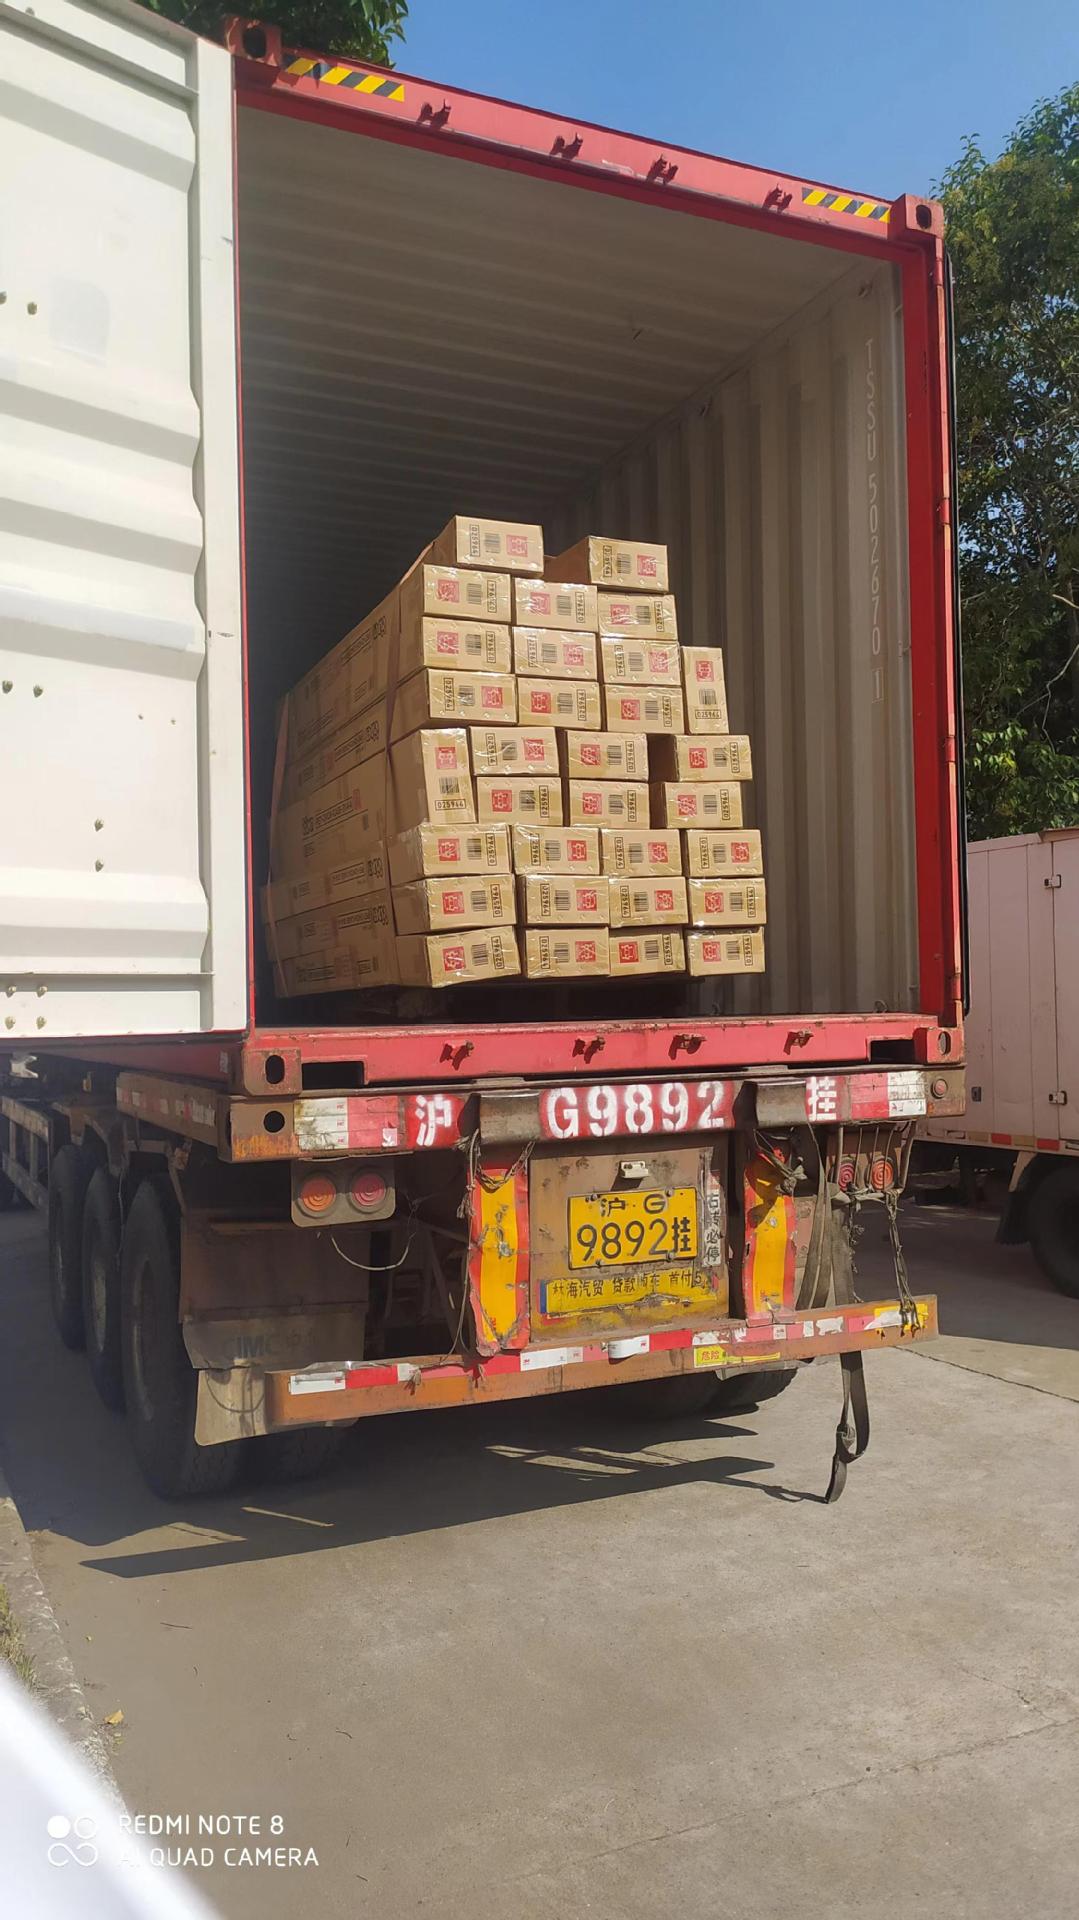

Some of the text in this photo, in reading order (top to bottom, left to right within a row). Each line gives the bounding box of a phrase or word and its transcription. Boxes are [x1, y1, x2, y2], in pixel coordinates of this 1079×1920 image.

[865, 339, 883, 701] TSSU 502670 1
[471, 525, 480, 556] 025964
[487, 632, 495, 662] 025964
[445, 679, 454, 710] 025964
[578, 690, 586, 719] 025964
[696, 710, 721, 718] 025964
[486, 734, 497, 765] 02594
[626, 742, 635, 771] 025964
[436, 800, 465, 810] 025964
[540, 786, 549, 817] 025964
[628, 791, 636, 821] 025964
[721, 790, 729, 819] 025964
[487, 834, 496, 865] 025964
[531, 834, 540, 865] 25964
[615, 838, 624, 868] 025964
[700, 838, 708, 868] 025964
[491, 885, 502, 916] 025964
[541, 884, 551, 915] 025964
[621, 886, 630, 917] 025964
[540, 937, 550, 968] 025964
[663, 935, 672, 964] 025964
[743, 936, 752, 965] 025964
[415, 1076, 837, 1147] 沪 G9892 挂
[576, 1216, 692, 1262] 9892挂
[701, 1351, 720, 1361] 危险
